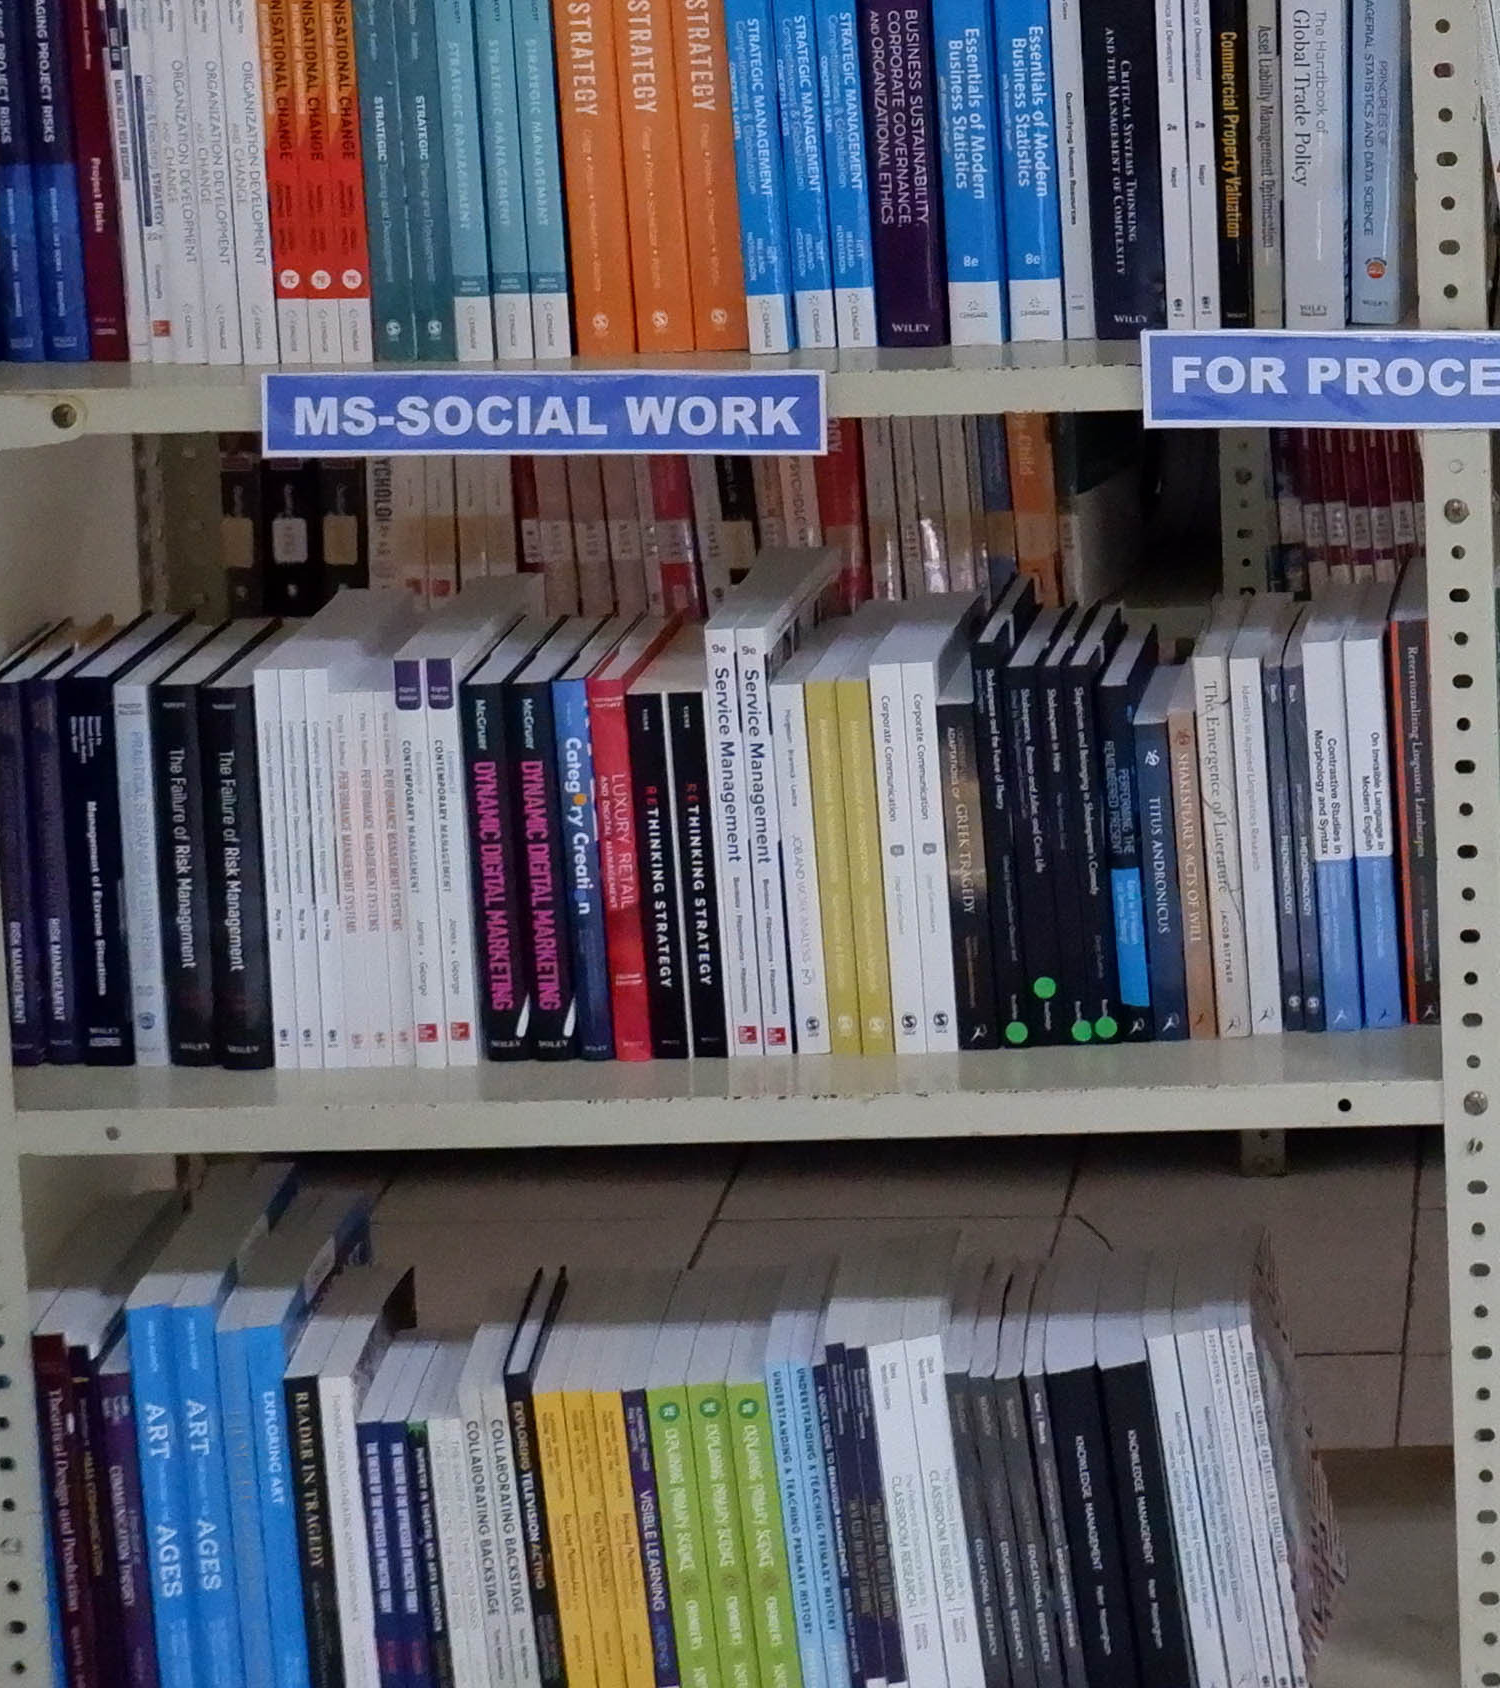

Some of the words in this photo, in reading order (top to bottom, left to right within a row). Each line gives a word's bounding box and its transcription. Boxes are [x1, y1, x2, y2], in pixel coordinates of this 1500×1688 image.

[36, 41, 52, 101] PROJECT
[566, 1, 599, 116] STRATEGY
[1220, 31, 1238, 110] Commercial
[41, 104, 55, 142] RISKS
[1219, 114, 1240, 173] Property
[1225, 176, 1241, 237] Valuation
[1171, 357, 1287, 393] FOR
[294, 395, 607, 436] MS-SOCIAL
[625, 396, 801, 435] WORK
[743, 668, 764, 737] Service
[470, 759, 503, 841] DYNAMIC
[745, 742, 772, 863] Management
[477, 843, 507, 906] DIGITAL
[482, 908, 516, 1011] MARKETING
